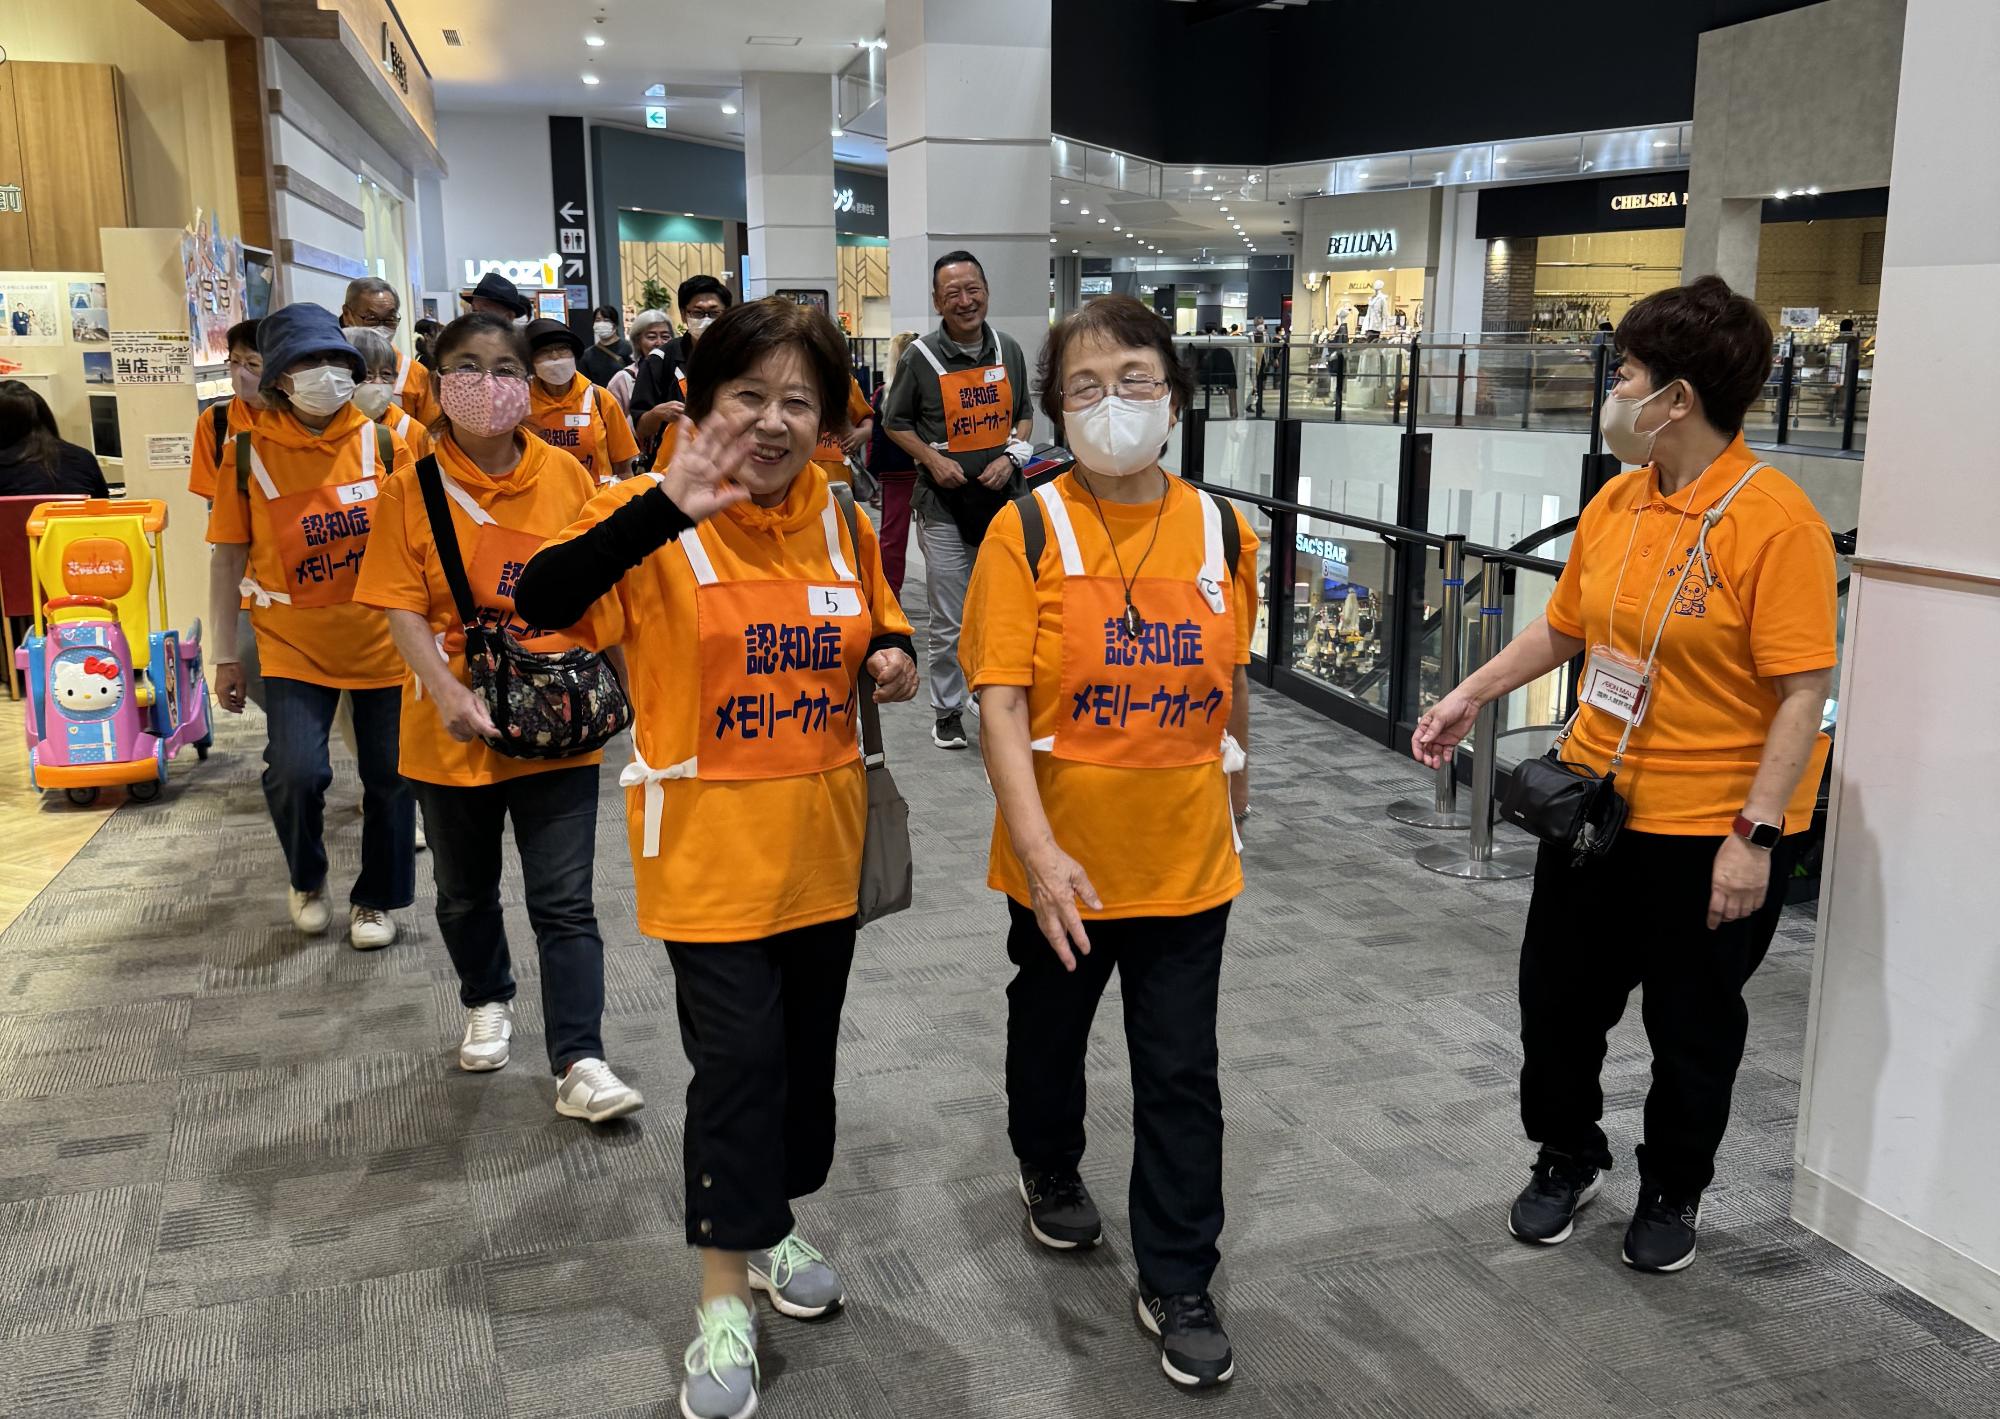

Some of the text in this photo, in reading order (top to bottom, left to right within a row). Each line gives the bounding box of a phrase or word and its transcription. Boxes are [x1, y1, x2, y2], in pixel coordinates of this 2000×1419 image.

[1611, 192, 1678, 210] CHELSEA
[1327, 232, 1393, 255] BELLUNA
[959, 384, 1000, 409] 認知症
[573, 416, 580, 425] 5
[351, 486, 363, 500] 5
[301, 506, 371, 547] 認知症
[1295, 533, 1347, 564] SAC'S BAR
[295, 545, 366, 585] メモリーウ
[825, 591, 839, 613] 5
[744, 621, 842, 675] 認知症
[1104, 617, 1204, 667] 認知症
